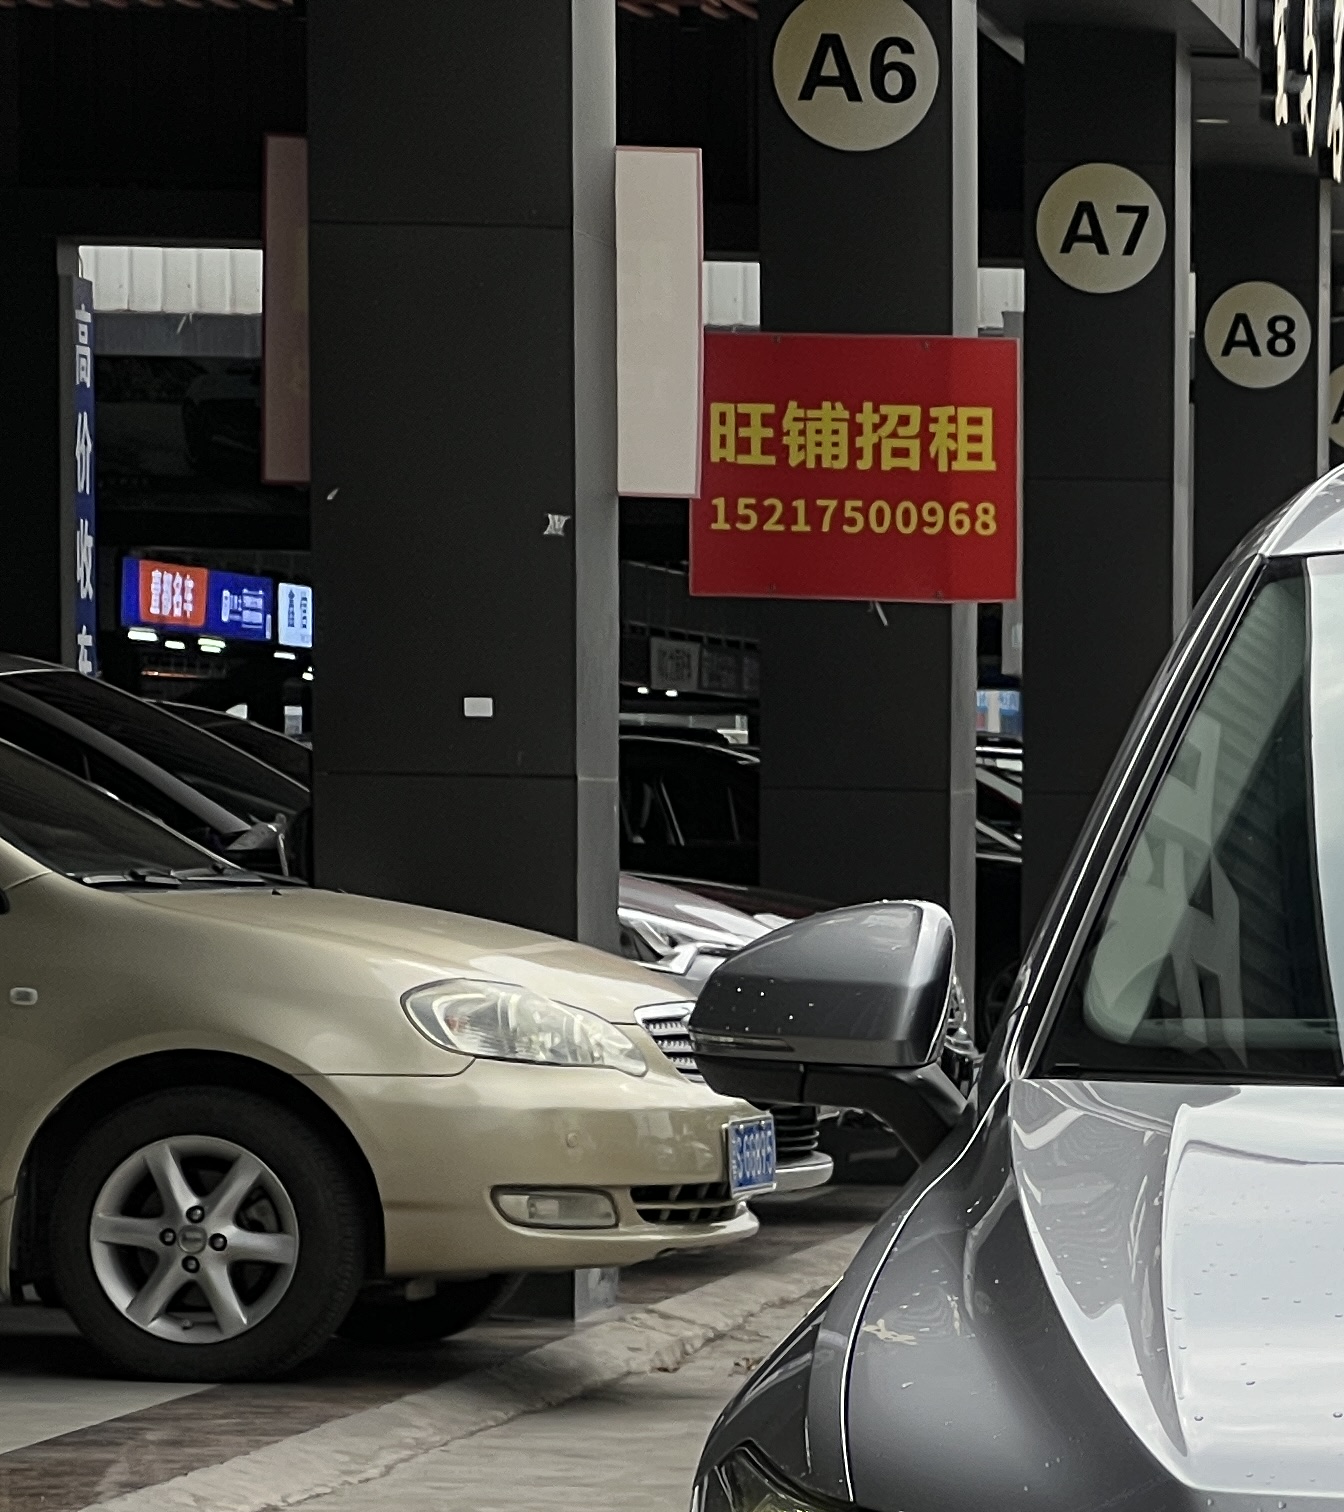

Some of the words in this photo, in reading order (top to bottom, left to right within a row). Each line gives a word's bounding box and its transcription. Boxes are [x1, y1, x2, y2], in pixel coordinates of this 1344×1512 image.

[797, 32, 919, 104] A6
[1059, 200, 1151, 257] A7
[1221, 313, 1298, 359] A8
[709, 400, 997, 472] 旺铺招租
[710, 497, 998, 536] 15217500968
